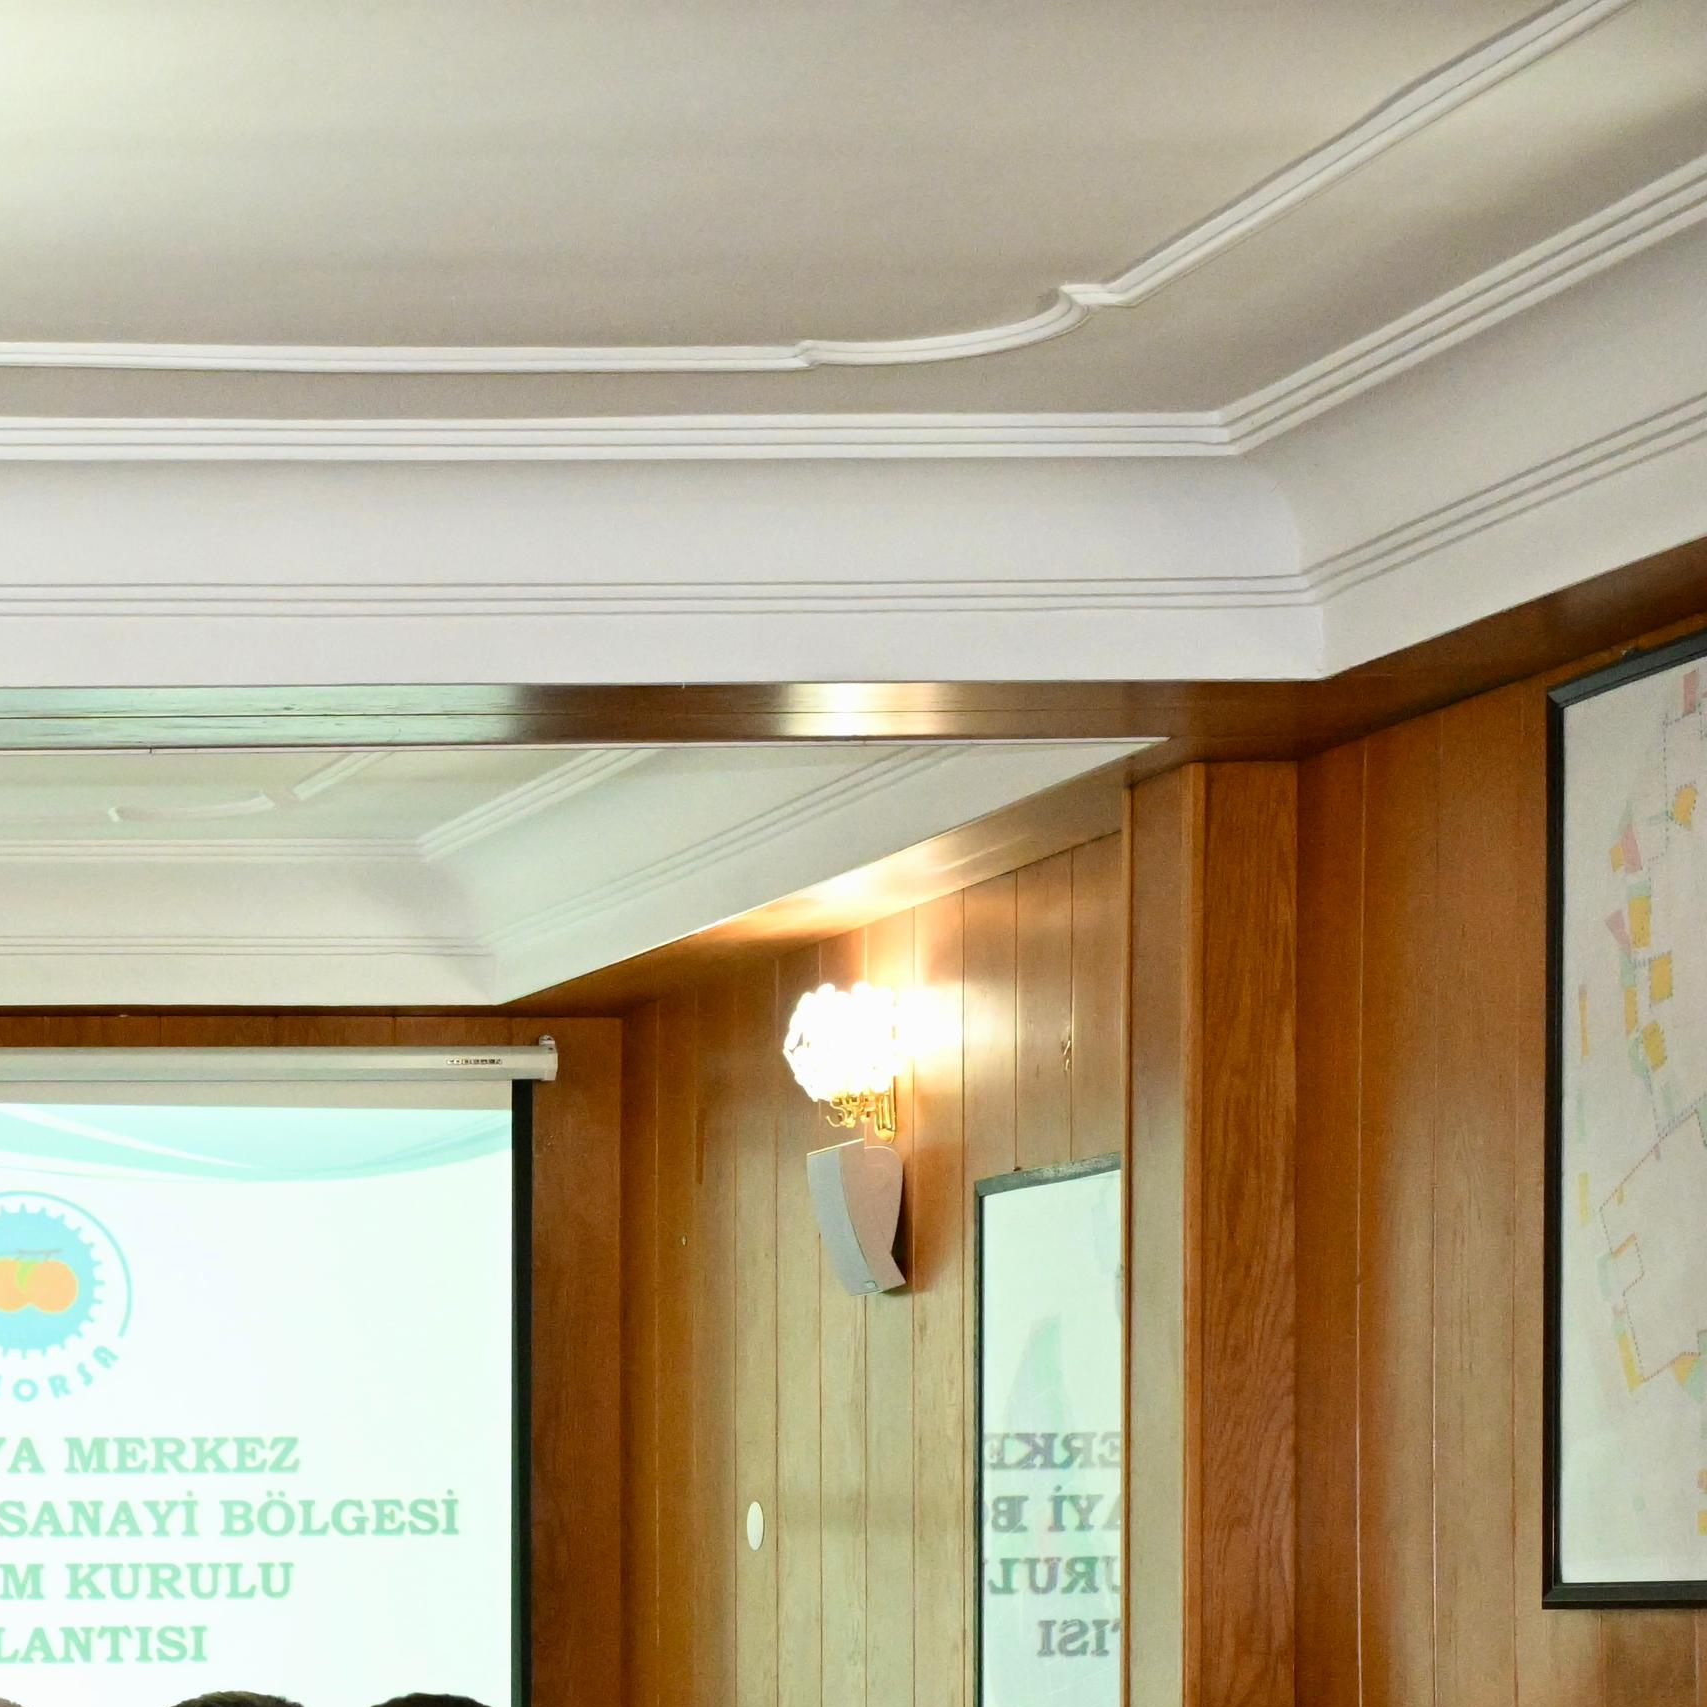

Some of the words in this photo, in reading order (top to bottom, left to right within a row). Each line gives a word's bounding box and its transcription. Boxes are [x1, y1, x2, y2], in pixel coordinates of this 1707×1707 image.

[65, 1436, 301, 1475] MERKEZ
[220, 1488, 460, 1538] BÖLGESİ
[66, 1562, 296, 1601] KURULU
